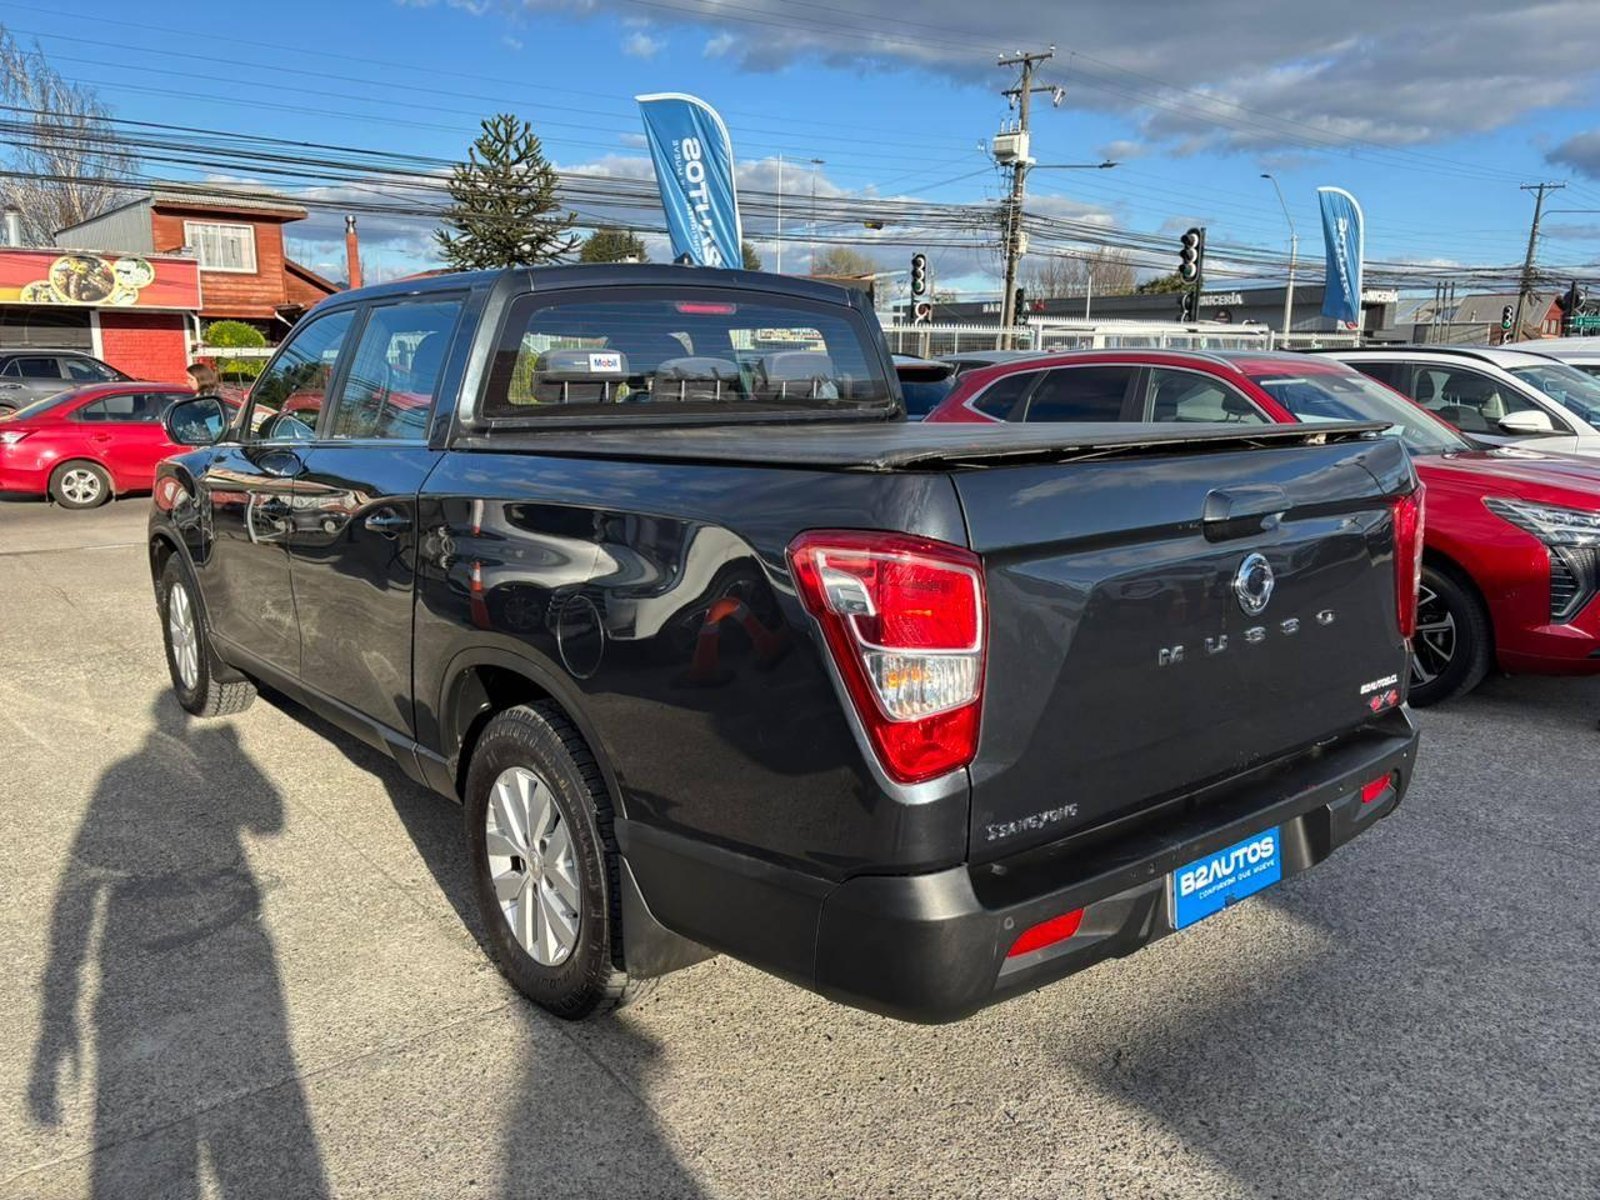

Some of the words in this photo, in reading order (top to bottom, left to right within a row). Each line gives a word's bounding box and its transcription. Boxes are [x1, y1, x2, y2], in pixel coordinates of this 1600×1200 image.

[594, 358, 618, 368] Mobil
[1158, 609, 1336, 667] MUSSO
[1180, 836, 1275, 897] B2AUTOS
